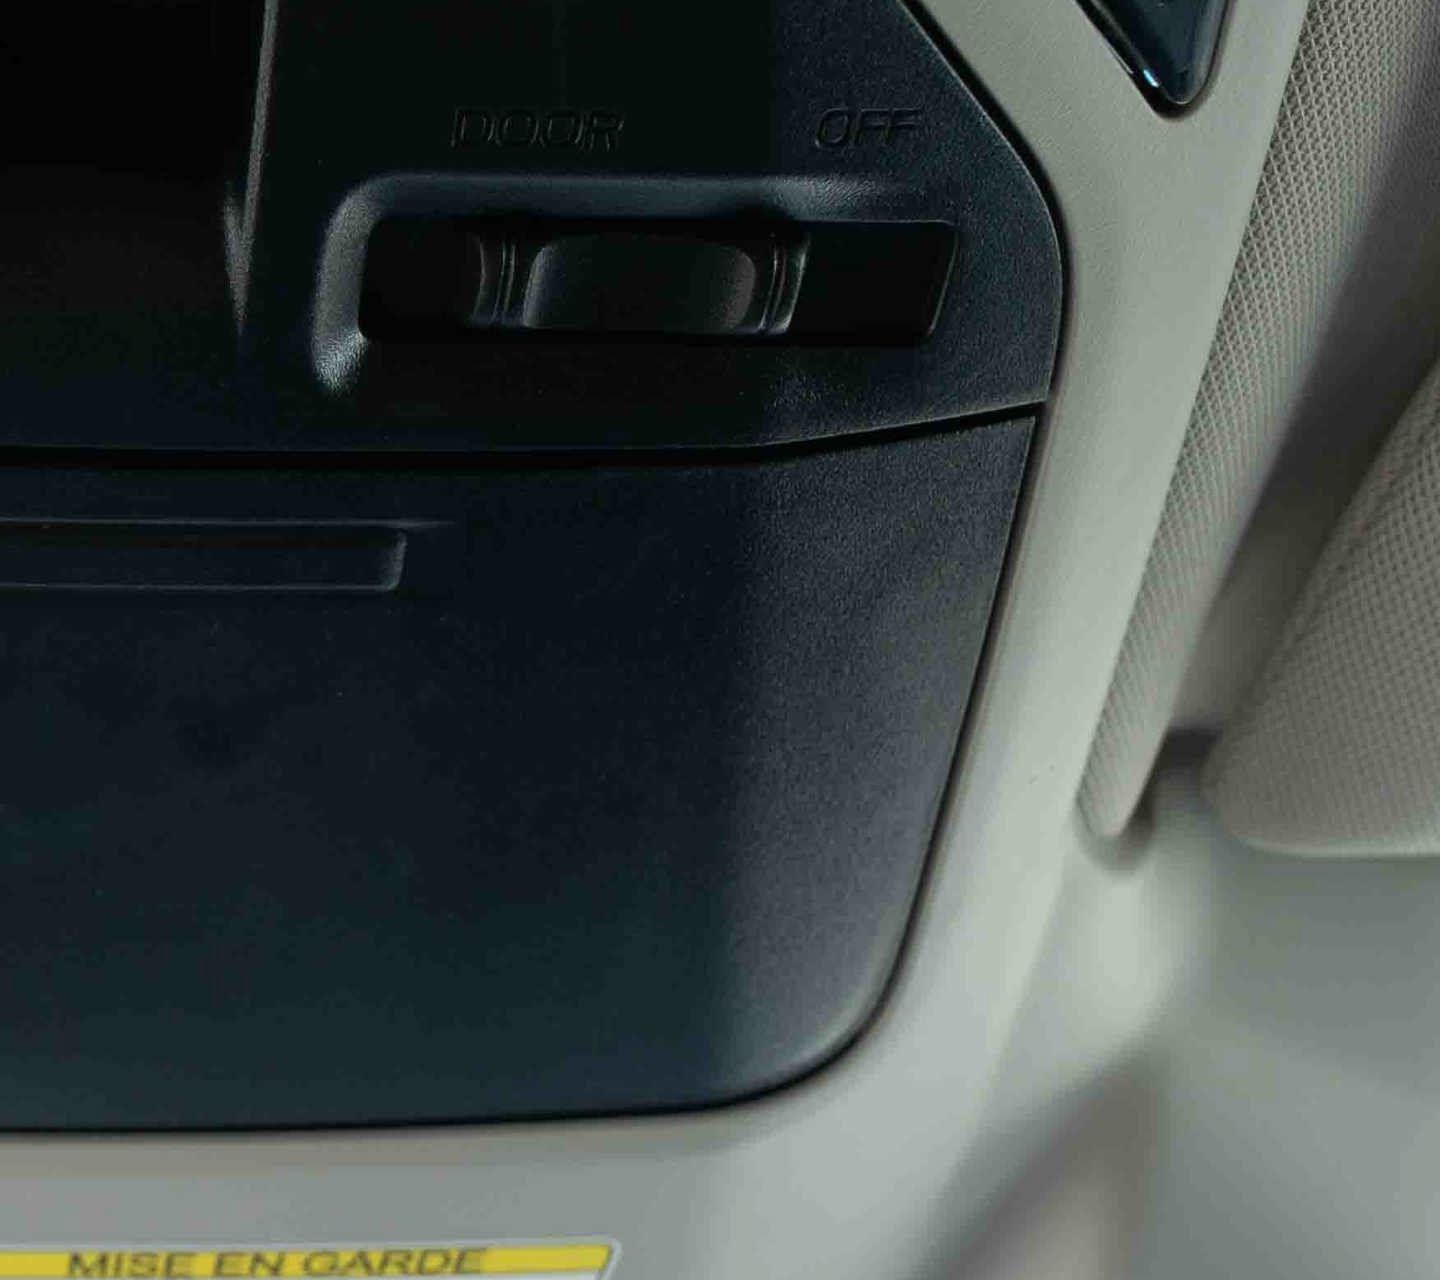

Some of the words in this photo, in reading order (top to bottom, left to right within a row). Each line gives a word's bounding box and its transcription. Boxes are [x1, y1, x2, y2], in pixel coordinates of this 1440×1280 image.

[451, 106, 623, 151] DOOR
[814, 107, 923, 150] OFF
[67, 1250, 195, 1279] MISE
[212, 1250, 285, 1278] EN
[303, 1246, 489, 1277] GARDE
